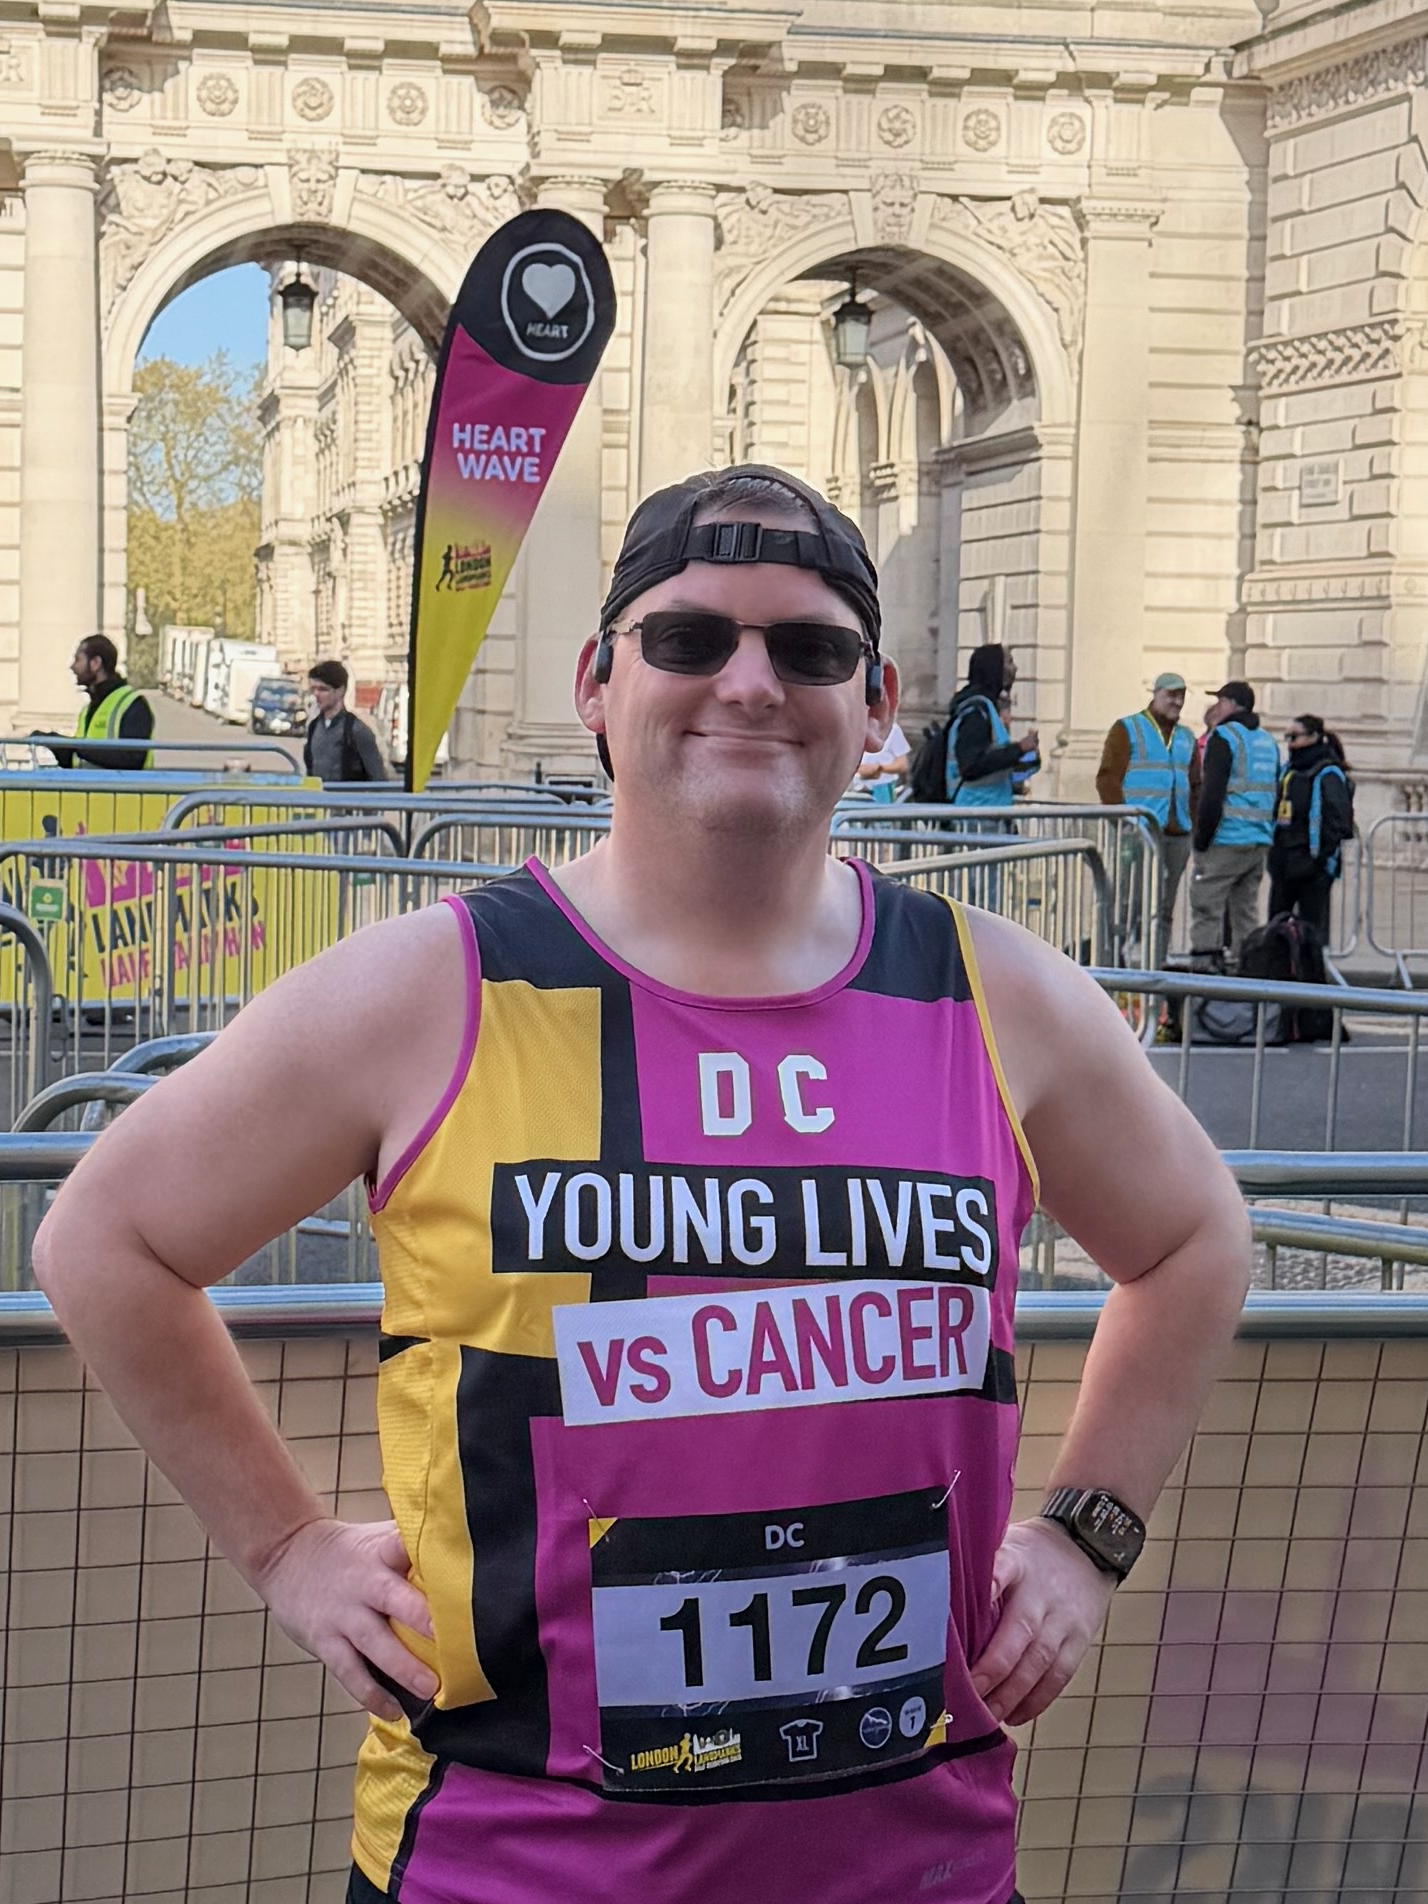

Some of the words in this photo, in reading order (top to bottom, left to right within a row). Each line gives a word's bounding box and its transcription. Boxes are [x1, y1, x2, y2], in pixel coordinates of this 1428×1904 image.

[526, 323, 569, 339] HEART
[452, 422, 547, 454] HEART
[456, 452, 541, 484] WAVE
[514, 1171, 777, 1266] YOUNG
[801, 1178, 992, 1275] LIVES
[691, 1285, 974, 1399] CANCER
[765, 1523, 805, 1550] DC
[660, 1576, 909, 1689] 1172
[631, 1745, 679, 1771] LONDON
[796, 1735, 808, 1752] XL
